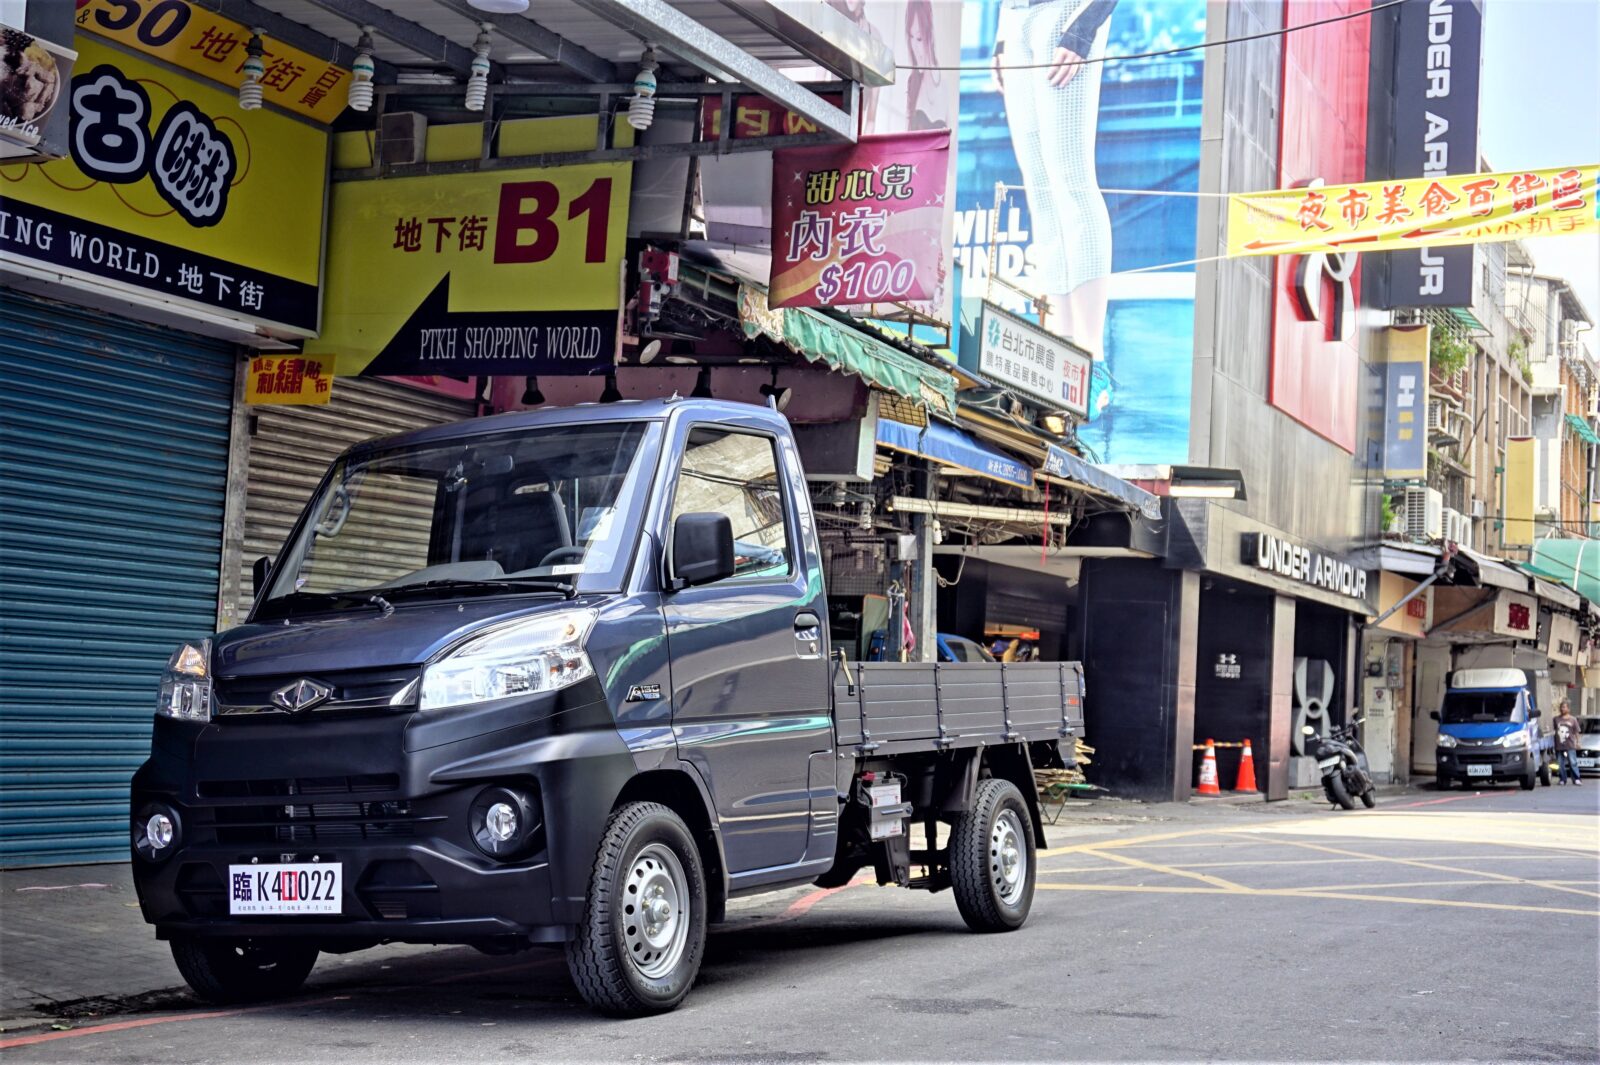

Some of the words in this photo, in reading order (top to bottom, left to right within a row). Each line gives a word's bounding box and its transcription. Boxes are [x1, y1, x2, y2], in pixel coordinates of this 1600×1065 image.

[805, 163, 913, 204] 甜心兒
[1297, 168, 1586, 232] 夜市美食百貨區
[1419, 111, 1449, 296] ARUR
[393, 215, 488, 253] 地下街
[493, 176, 613, 264] B1
[786, 207, 889, 262] 內衣
[1466, 213, 1586, 238] 小心扒手
[815, 260, 916, 304] $100
[419, 328, 457, 360] PTKH
[464, 326, 539, 359] SHOPPING
[547, 326, 601, 359] WORLD
[1258, 532, 1310, 582] UNDER
[1313, 553, 1367, 600] ARMOUR
